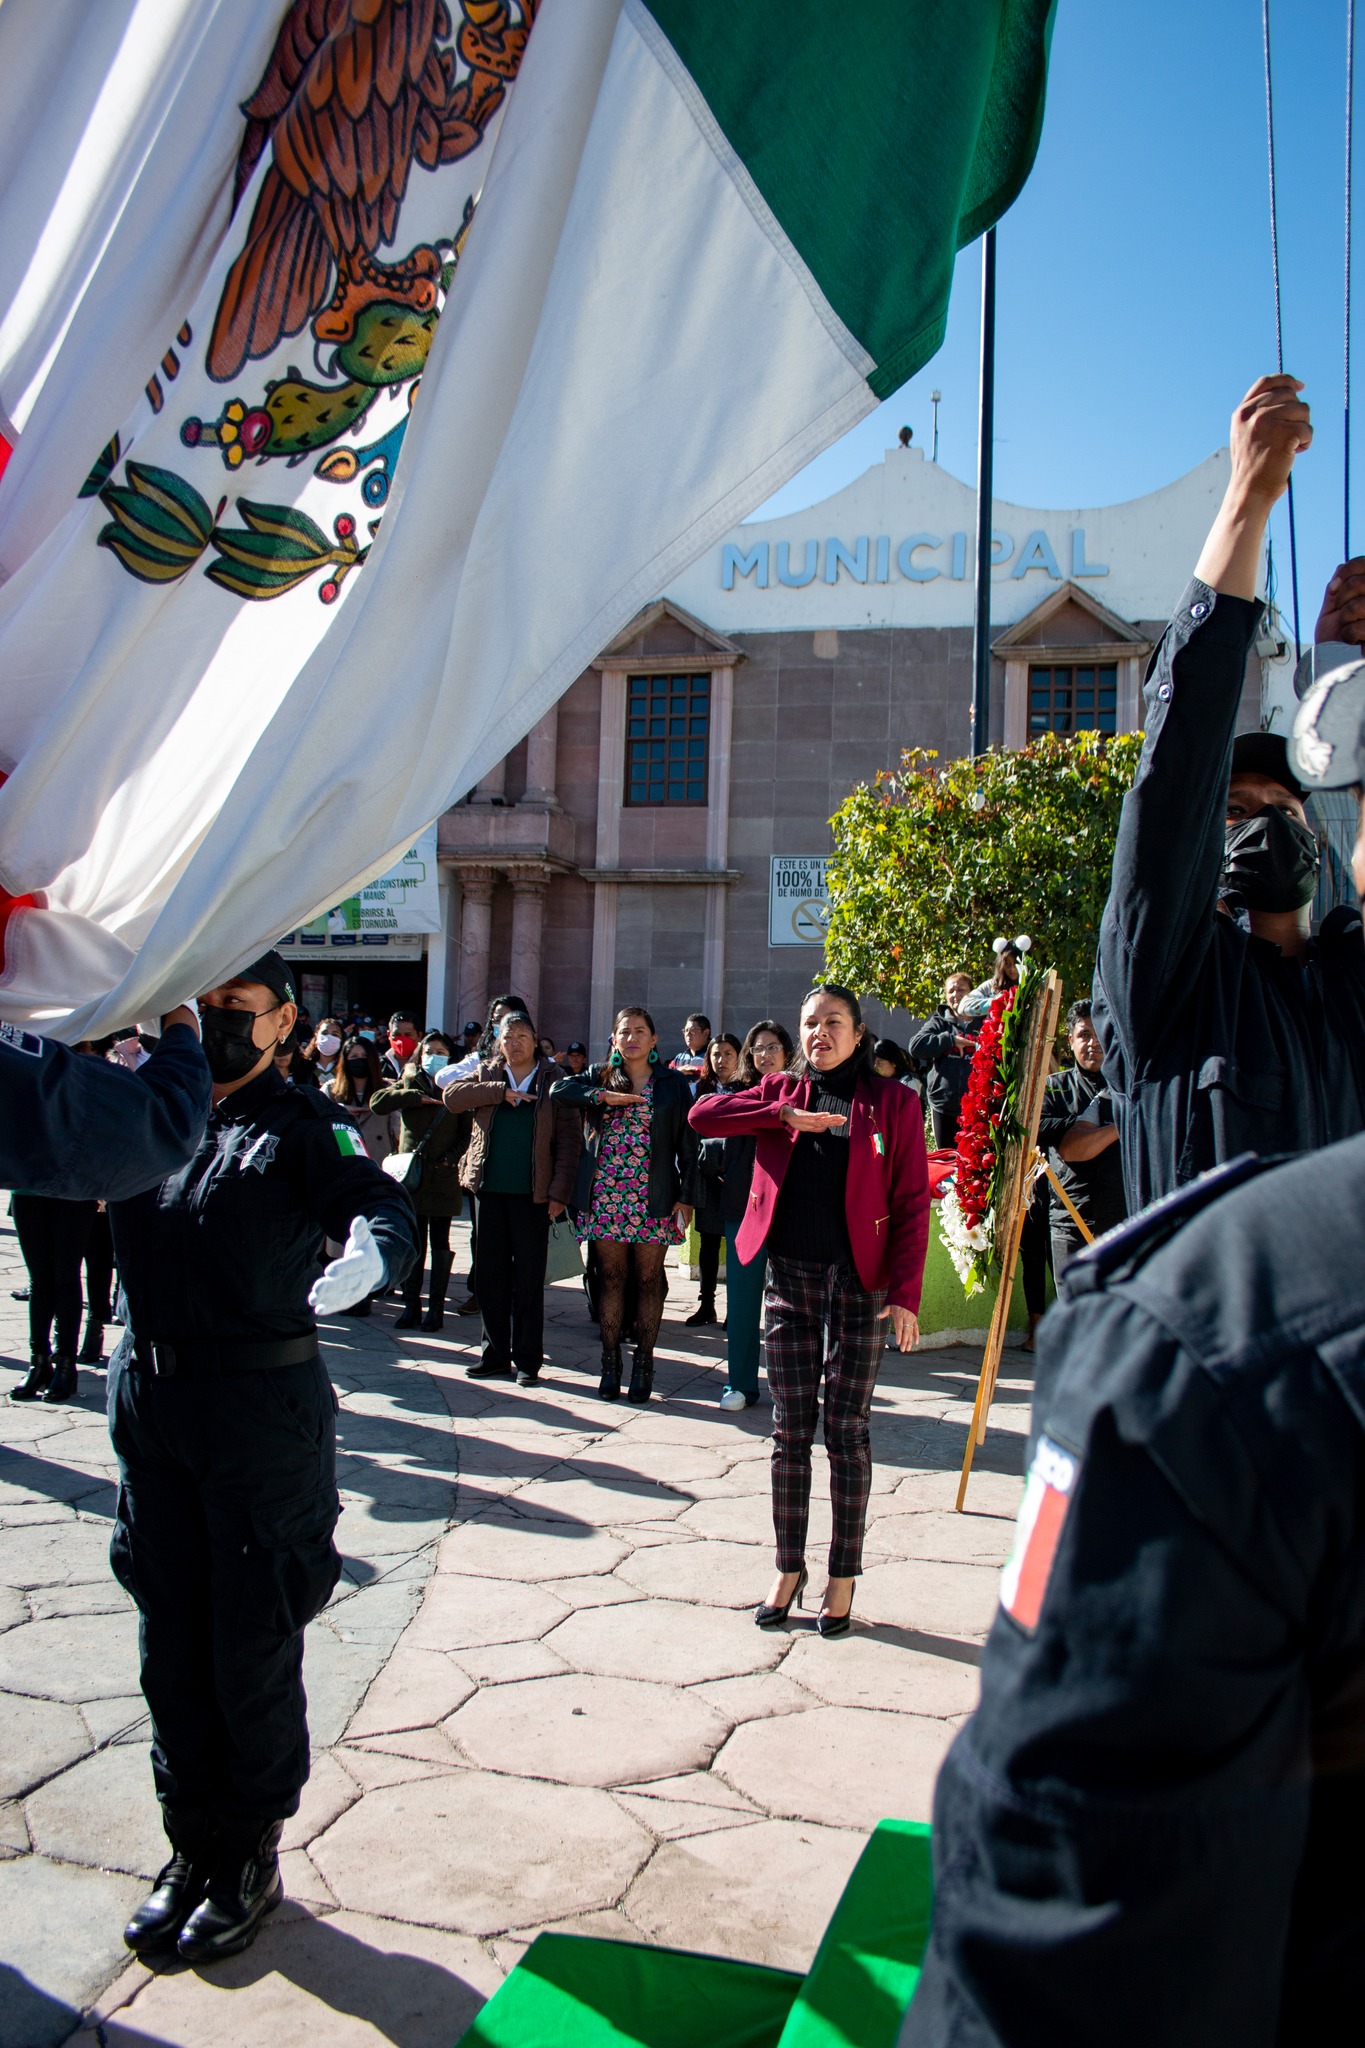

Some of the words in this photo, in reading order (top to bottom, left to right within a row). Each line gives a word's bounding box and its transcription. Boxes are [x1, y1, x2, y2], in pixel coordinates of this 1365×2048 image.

[721, 528, 1109, 591] MUNICIPAL
[779, 860, 796, 869] ESTE
[799, 860, 807, 869] ES
[810, 860, 820, 869] UN
[380, 878, 418, 888] CONSTANTE
[776, 871, 812, 887] 100%
[363, 890, 386, 900] MANOS
[778, 888, 787, 897] DE
[790, 888, 812, 897] HUMO
[815, 888, 824, 897] DE
[352, 908, 385, 918] CUBRIRSE
[386, 908, 395, 917] AL
[352, 918, 398, 929] ESTORNUDAR
